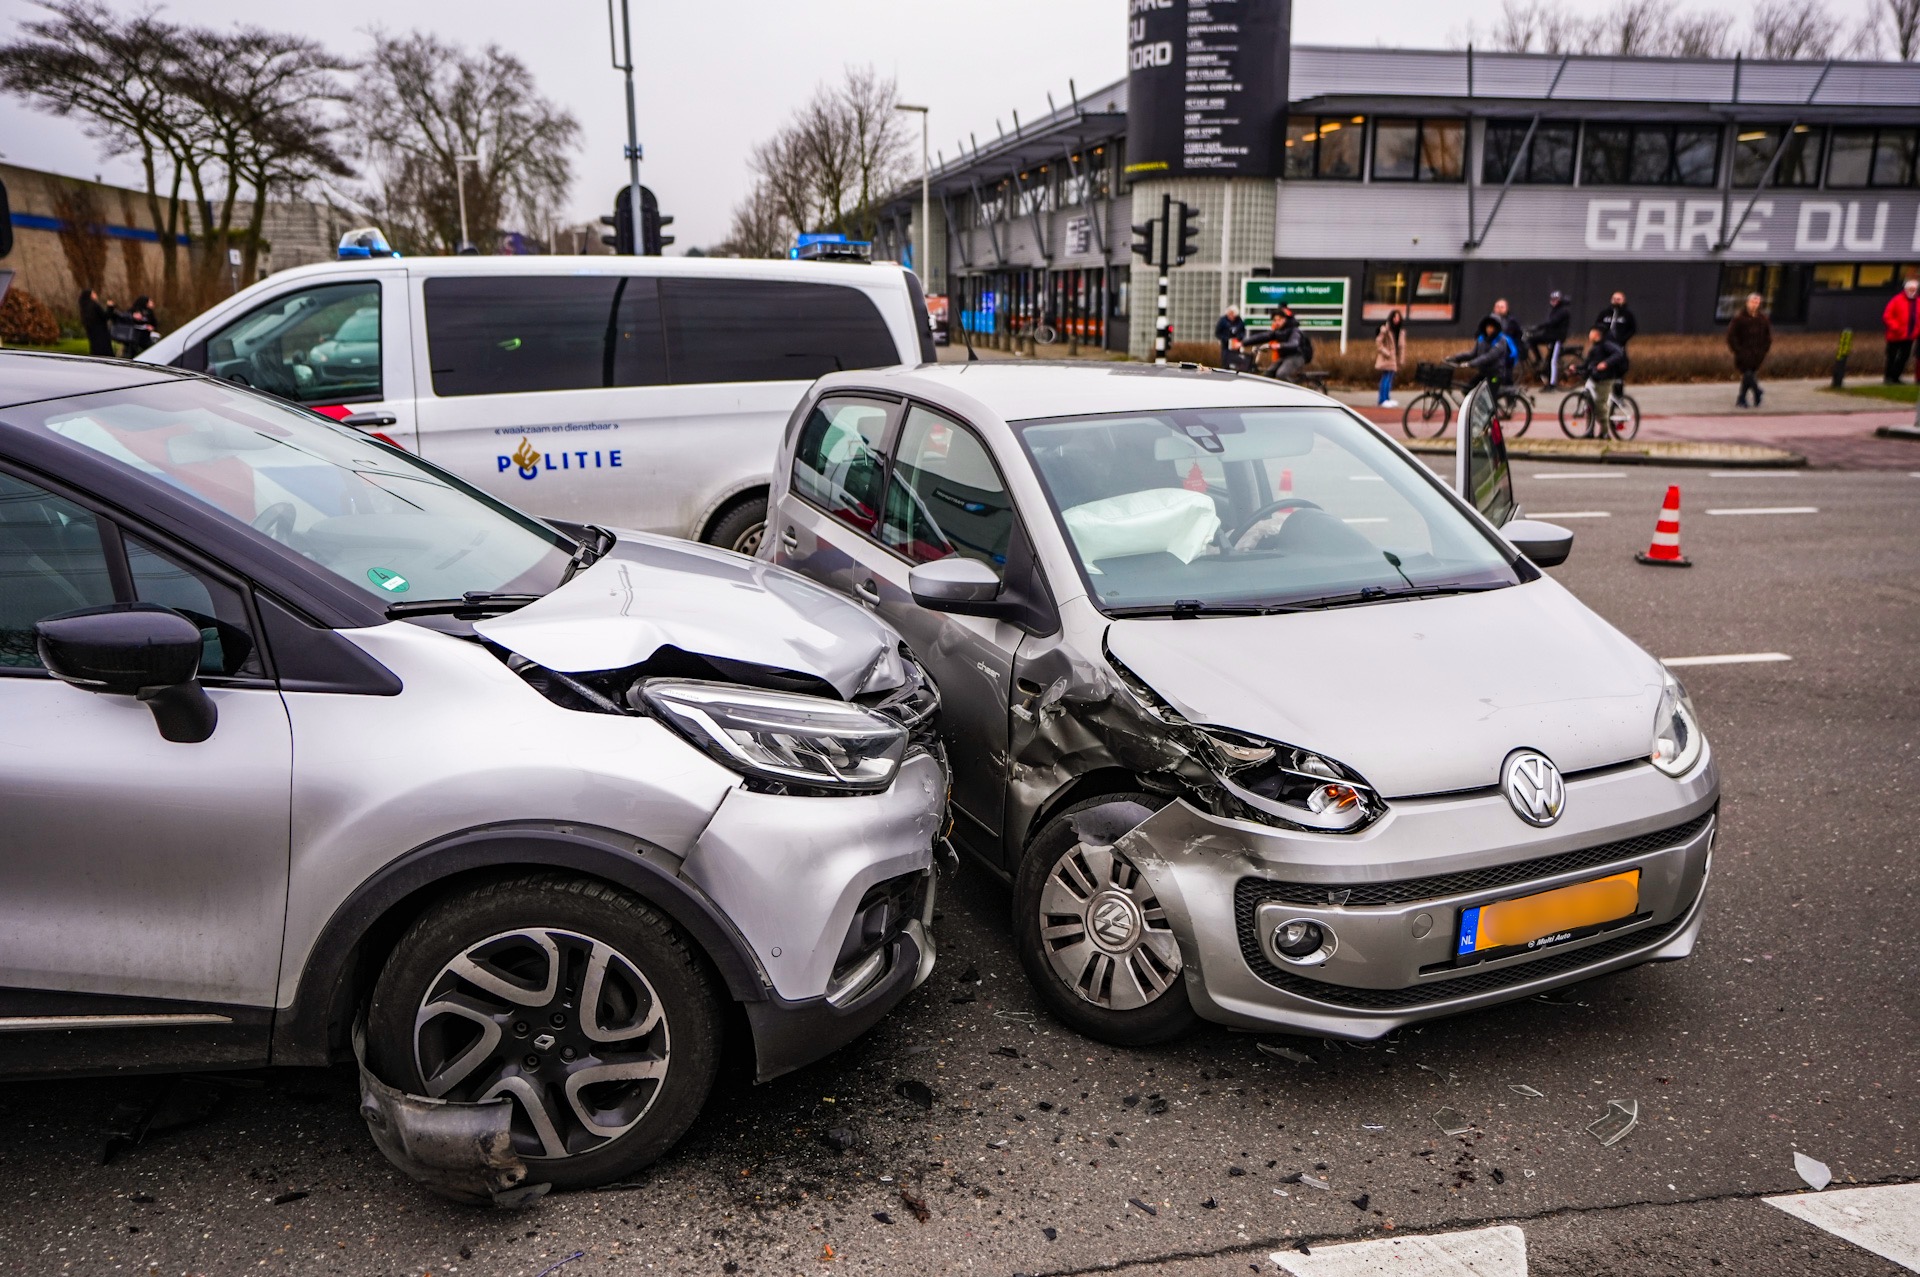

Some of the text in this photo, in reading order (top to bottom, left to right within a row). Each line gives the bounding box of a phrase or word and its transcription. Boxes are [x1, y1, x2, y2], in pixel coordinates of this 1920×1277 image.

[1585, 200, 1774, 251] GARE
[1795, 201, 1890, 251] DU
[1259, 286, 1286, 294] Welkom
[1295, 286, 1305, 294] de
[502, 425, 550, 435] waakzaam
[565, 422, 611, 432] dienstbaar
[497, 450, 622, 480] POLITIE
[977, 661, 1000, 678] cheer
[1461, 934, 1474, 946] NL
[1536, 932, 1571, 946] Multi Auto
